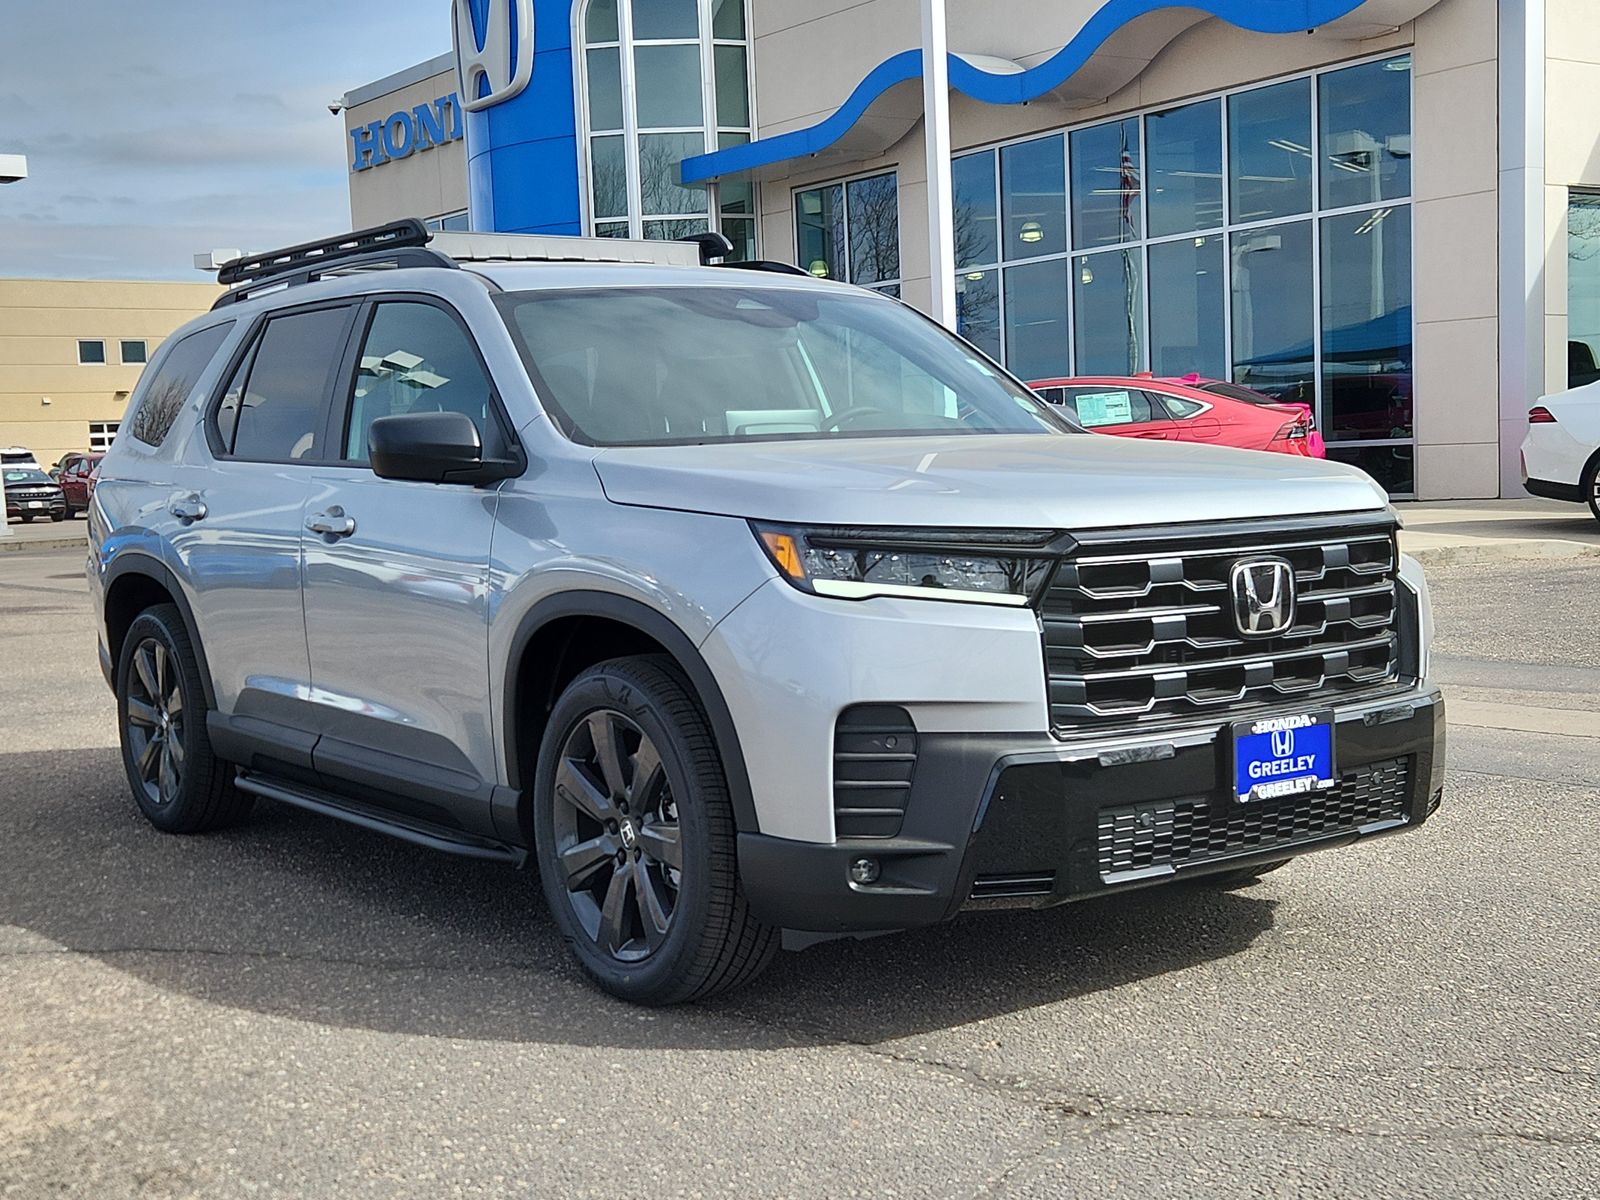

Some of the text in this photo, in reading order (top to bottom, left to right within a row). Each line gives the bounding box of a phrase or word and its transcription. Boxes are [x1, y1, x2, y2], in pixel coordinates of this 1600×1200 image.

[1255, 714, 1312, 734] HONDA
[1248, 754, 1316, 778] GREELEY
[1257, 777, 1312, 799] GREELEY
